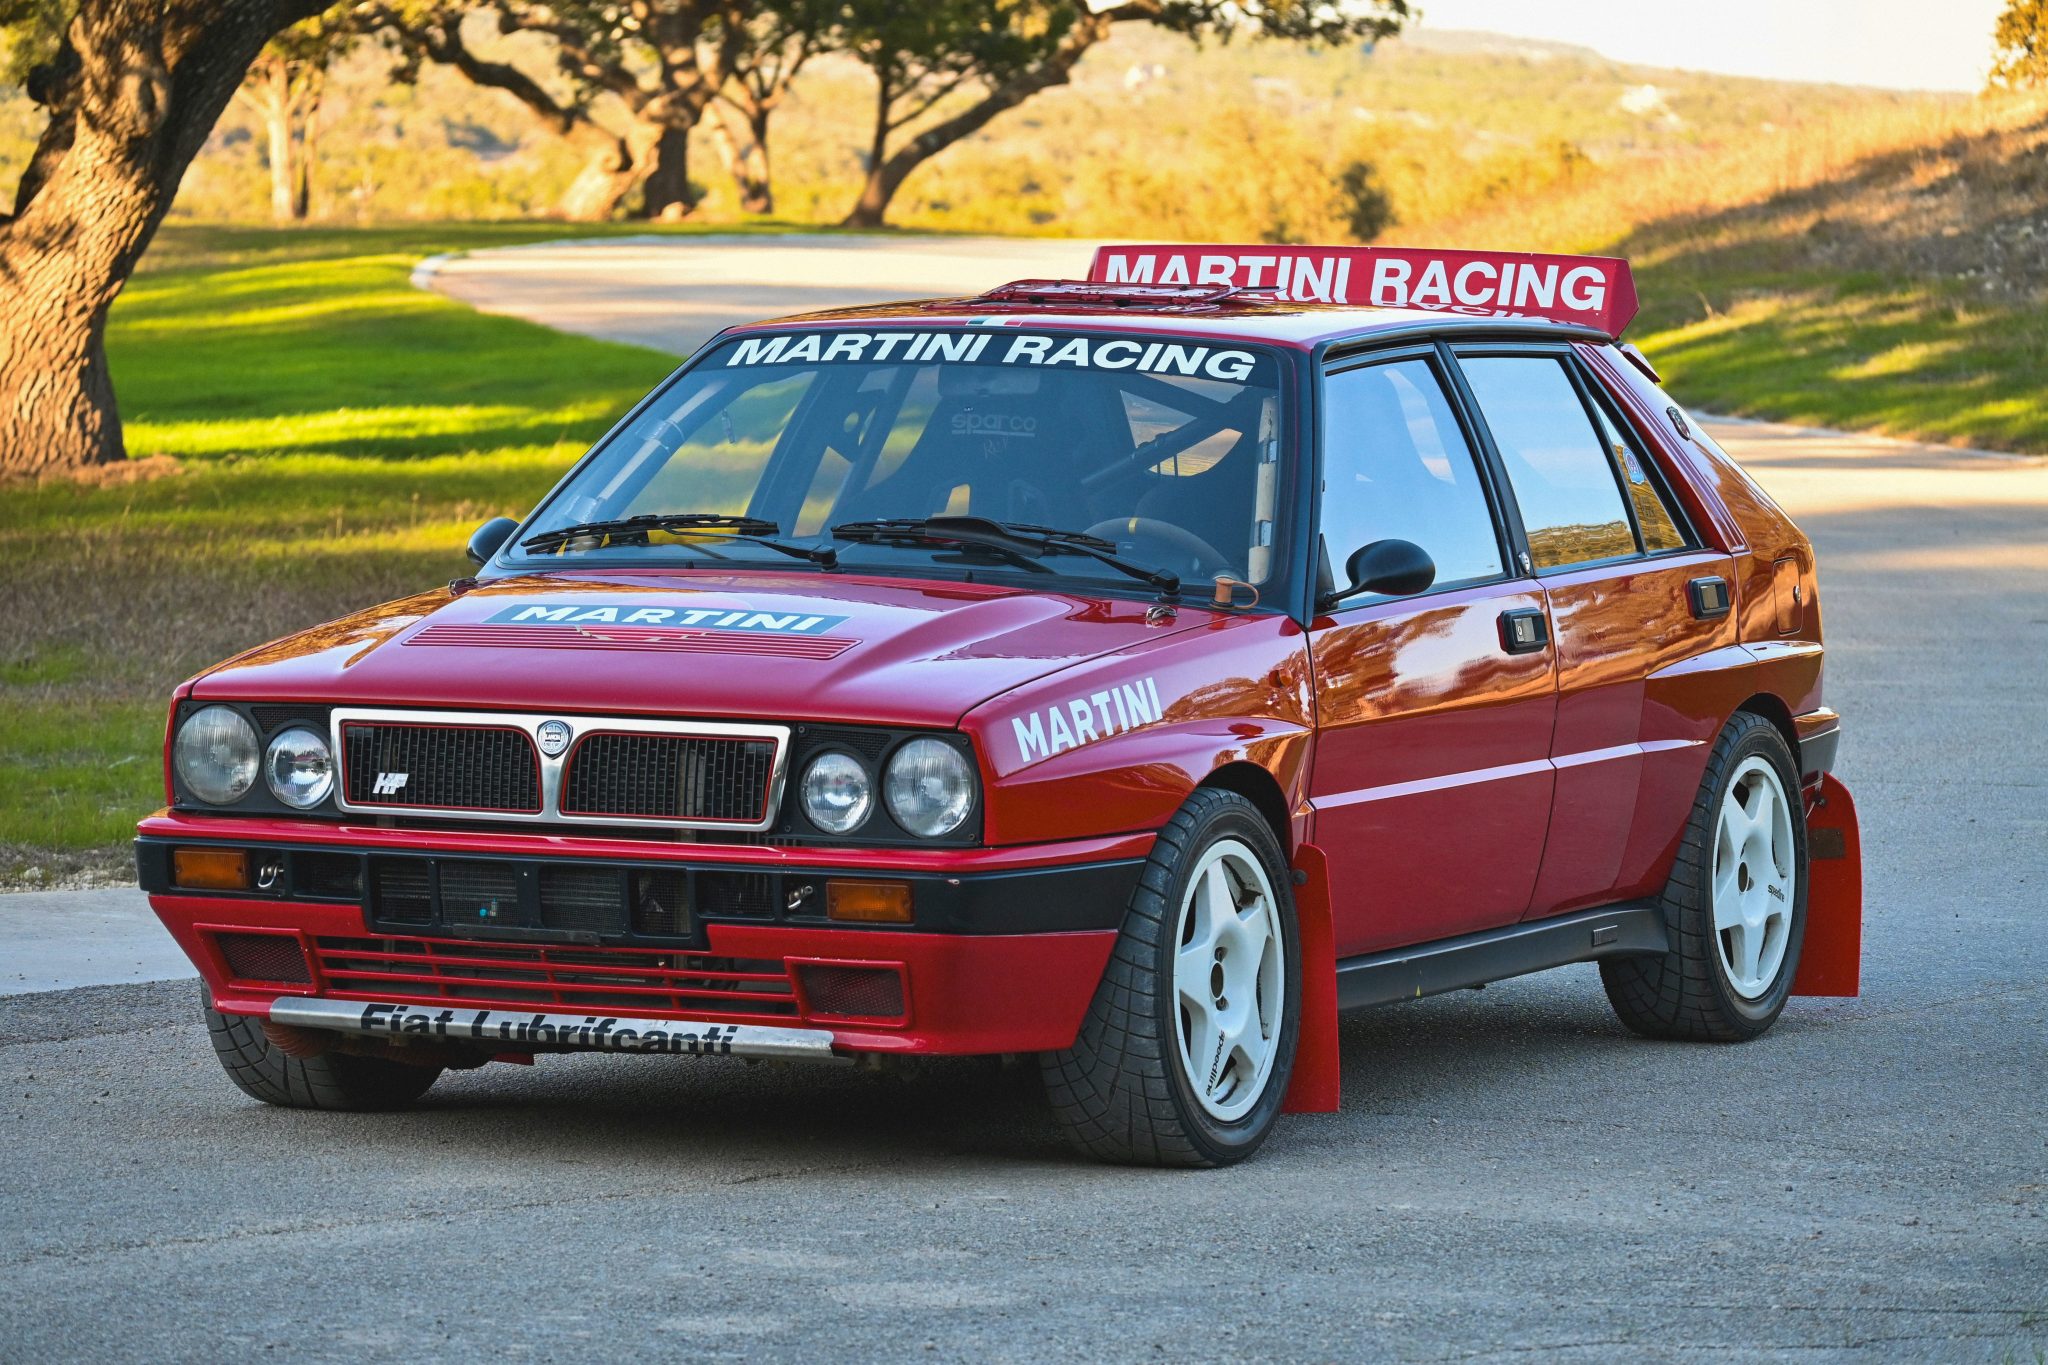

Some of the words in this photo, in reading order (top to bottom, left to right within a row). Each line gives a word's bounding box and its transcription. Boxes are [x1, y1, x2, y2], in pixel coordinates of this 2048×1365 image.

[1105, 254, 1351, 303] MARTINI
[1370, 258, 1606, 311] RACING
[726, 333, 993, 368] MARTINI
[1003, 335, 1256, 381] RACING
[951, 414, 1037, 434] sparco
[511, 605, 825, 633] MARTINI
[1011, 677, 1164, 763] MARTINI
[372, 772, 409, 794] HF
[361, 1003, 454, 1035] Fiat
[1205, 1029, 1225, 1097] speedline
